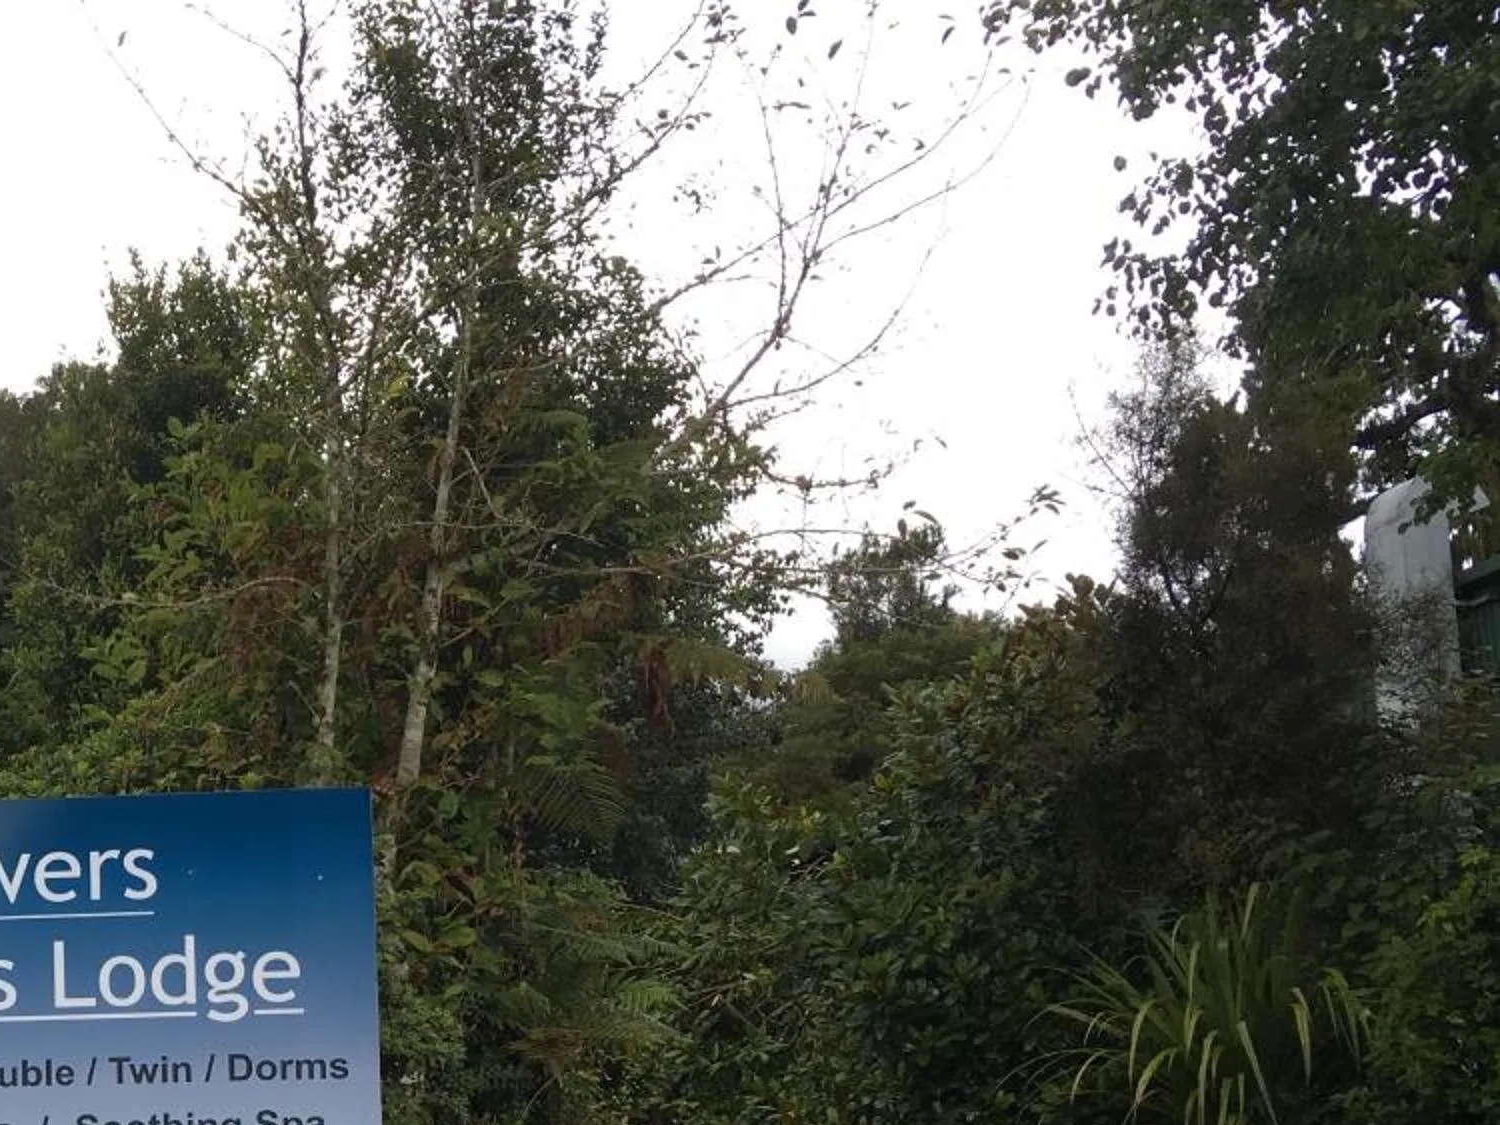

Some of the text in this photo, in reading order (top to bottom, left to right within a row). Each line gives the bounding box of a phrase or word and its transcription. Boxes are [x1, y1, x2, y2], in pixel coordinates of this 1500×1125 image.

[52, 934, 302, 1022] Lodge
[86, 1057, 98, 1086] /
[108, 1055, 193, 1085] Twin
[204, 1053, 216, 1083] /
[227, 1053, 349, 1082] Dorms
